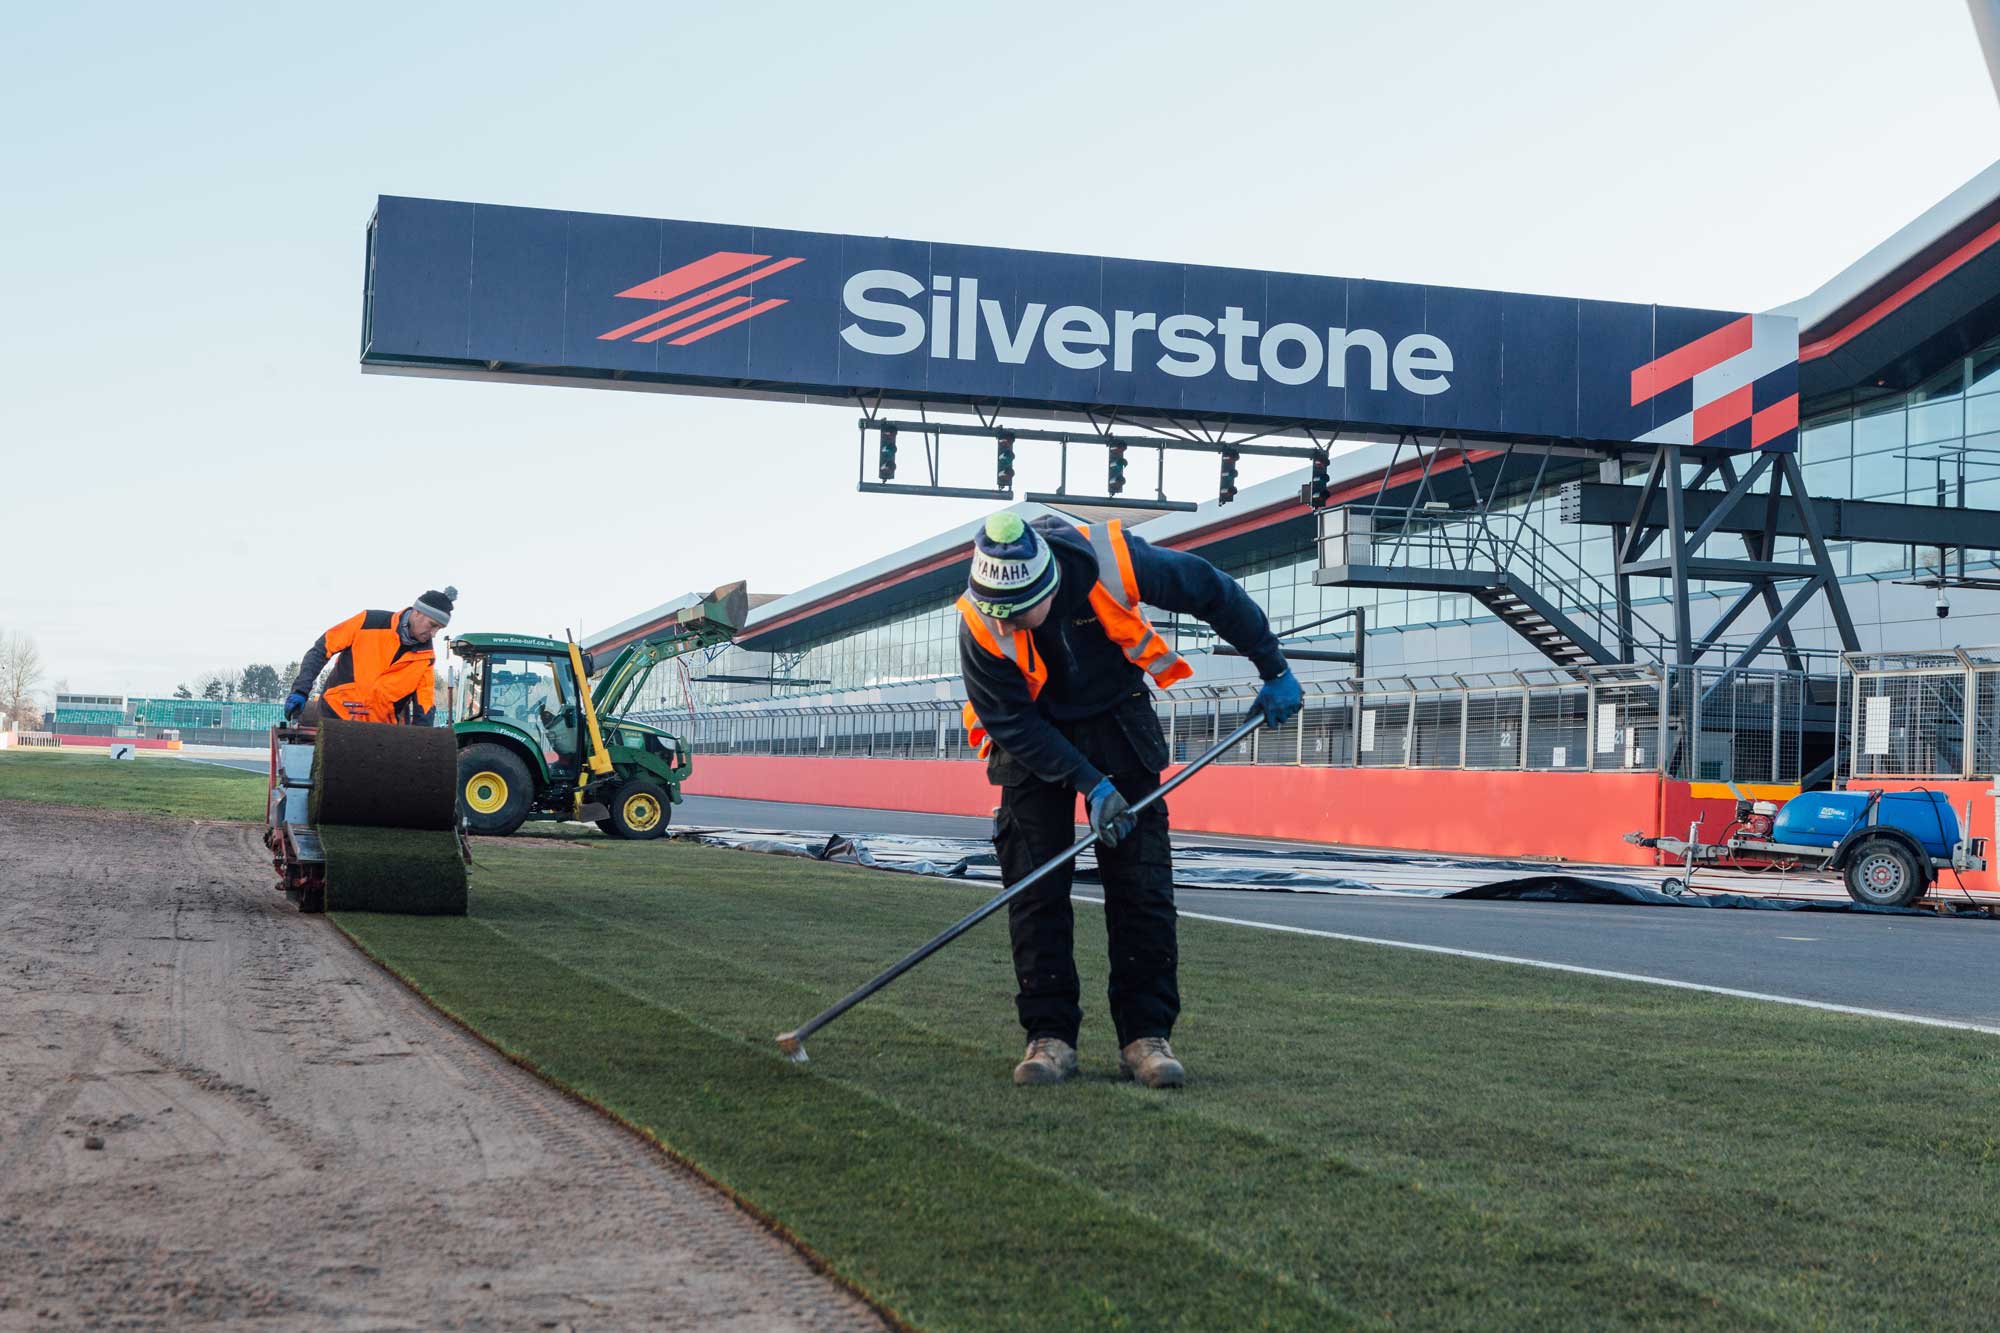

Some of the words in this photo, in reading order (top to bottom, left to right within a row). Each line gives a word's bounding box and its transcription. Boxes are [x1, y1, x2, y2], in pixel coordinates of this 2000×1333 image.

[840, 269, 1454, 395] Silverstone
[979, 560, 1029, 581] YAMAHA
[976, 601, 1013, 618] 46
[493, 637, 554, 647] www.fine-turf.co.uk
[1500, 733, 1511, 747] 22
